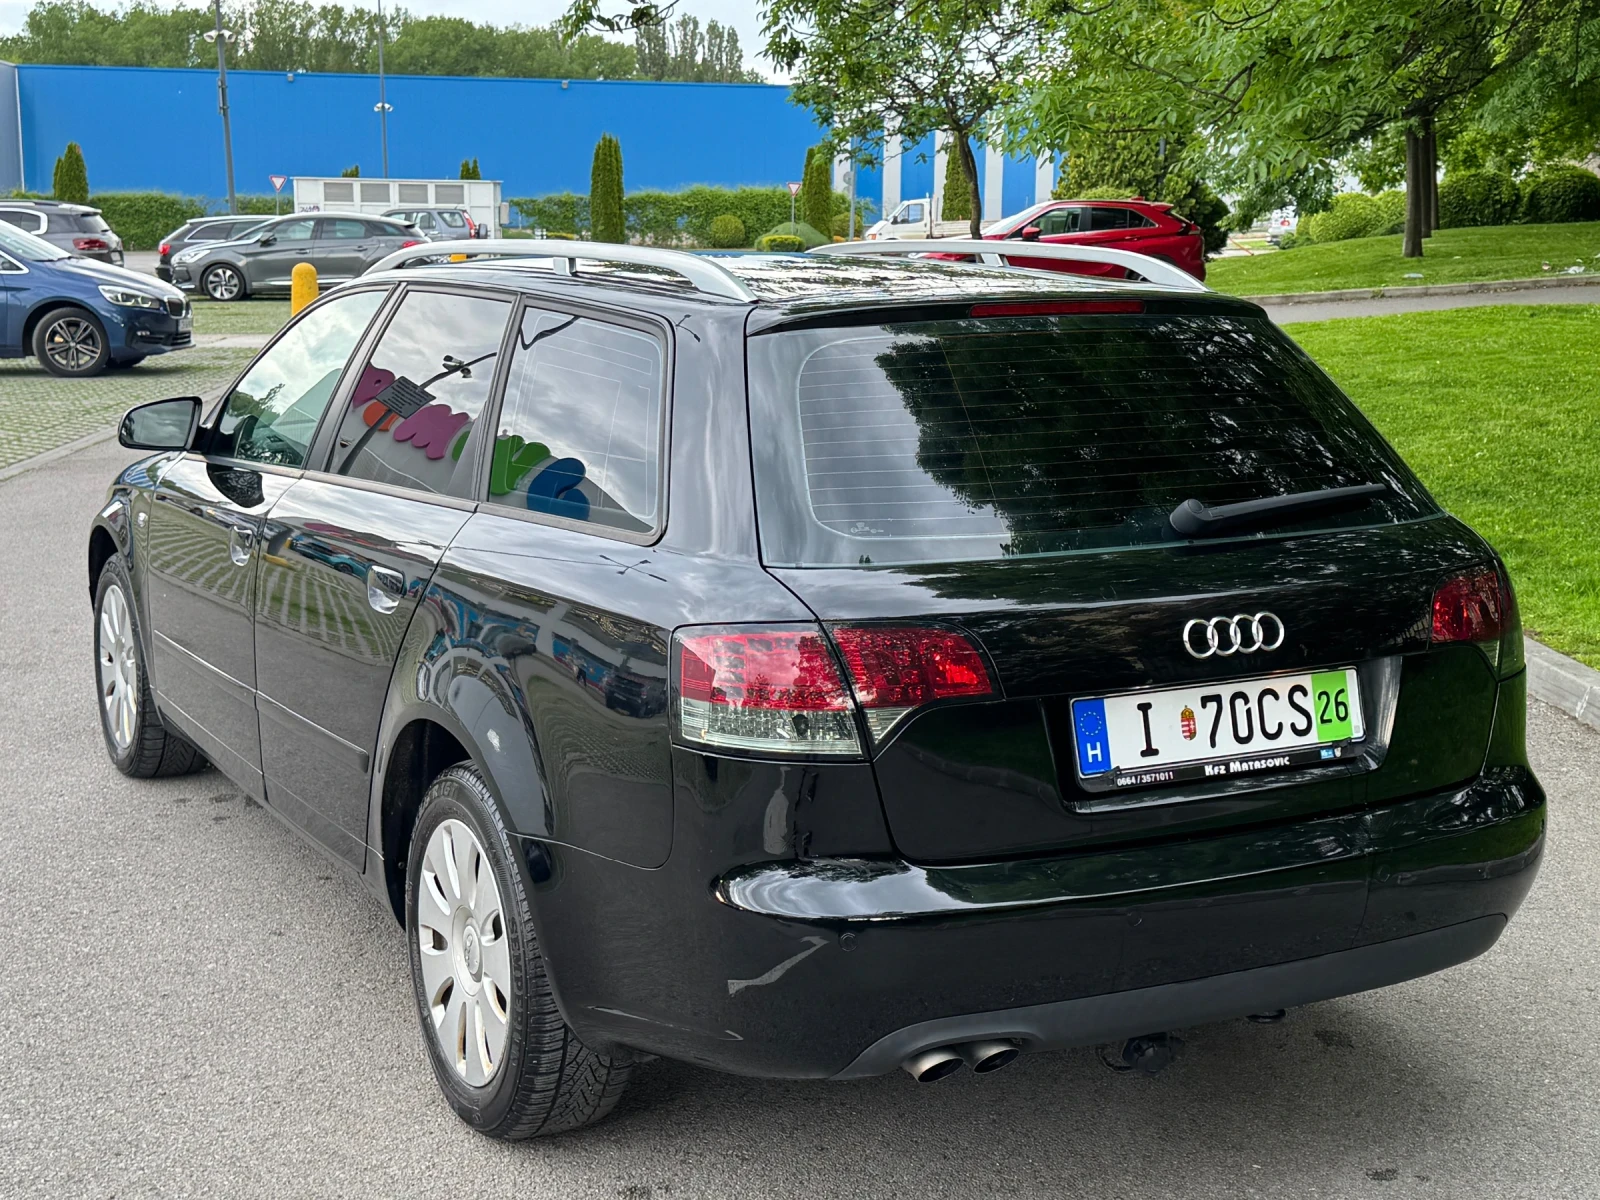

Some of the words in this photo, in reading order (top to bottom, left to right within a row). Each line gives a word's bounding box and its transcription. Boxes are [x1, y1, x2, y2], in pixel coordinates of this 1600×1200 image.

[1137, 702, 1160, 758] I
[1200, 684, 1313, 749] 70CS
[1317, 688, 1349, 725] 26
[1087, 741, 1103, 763] H
